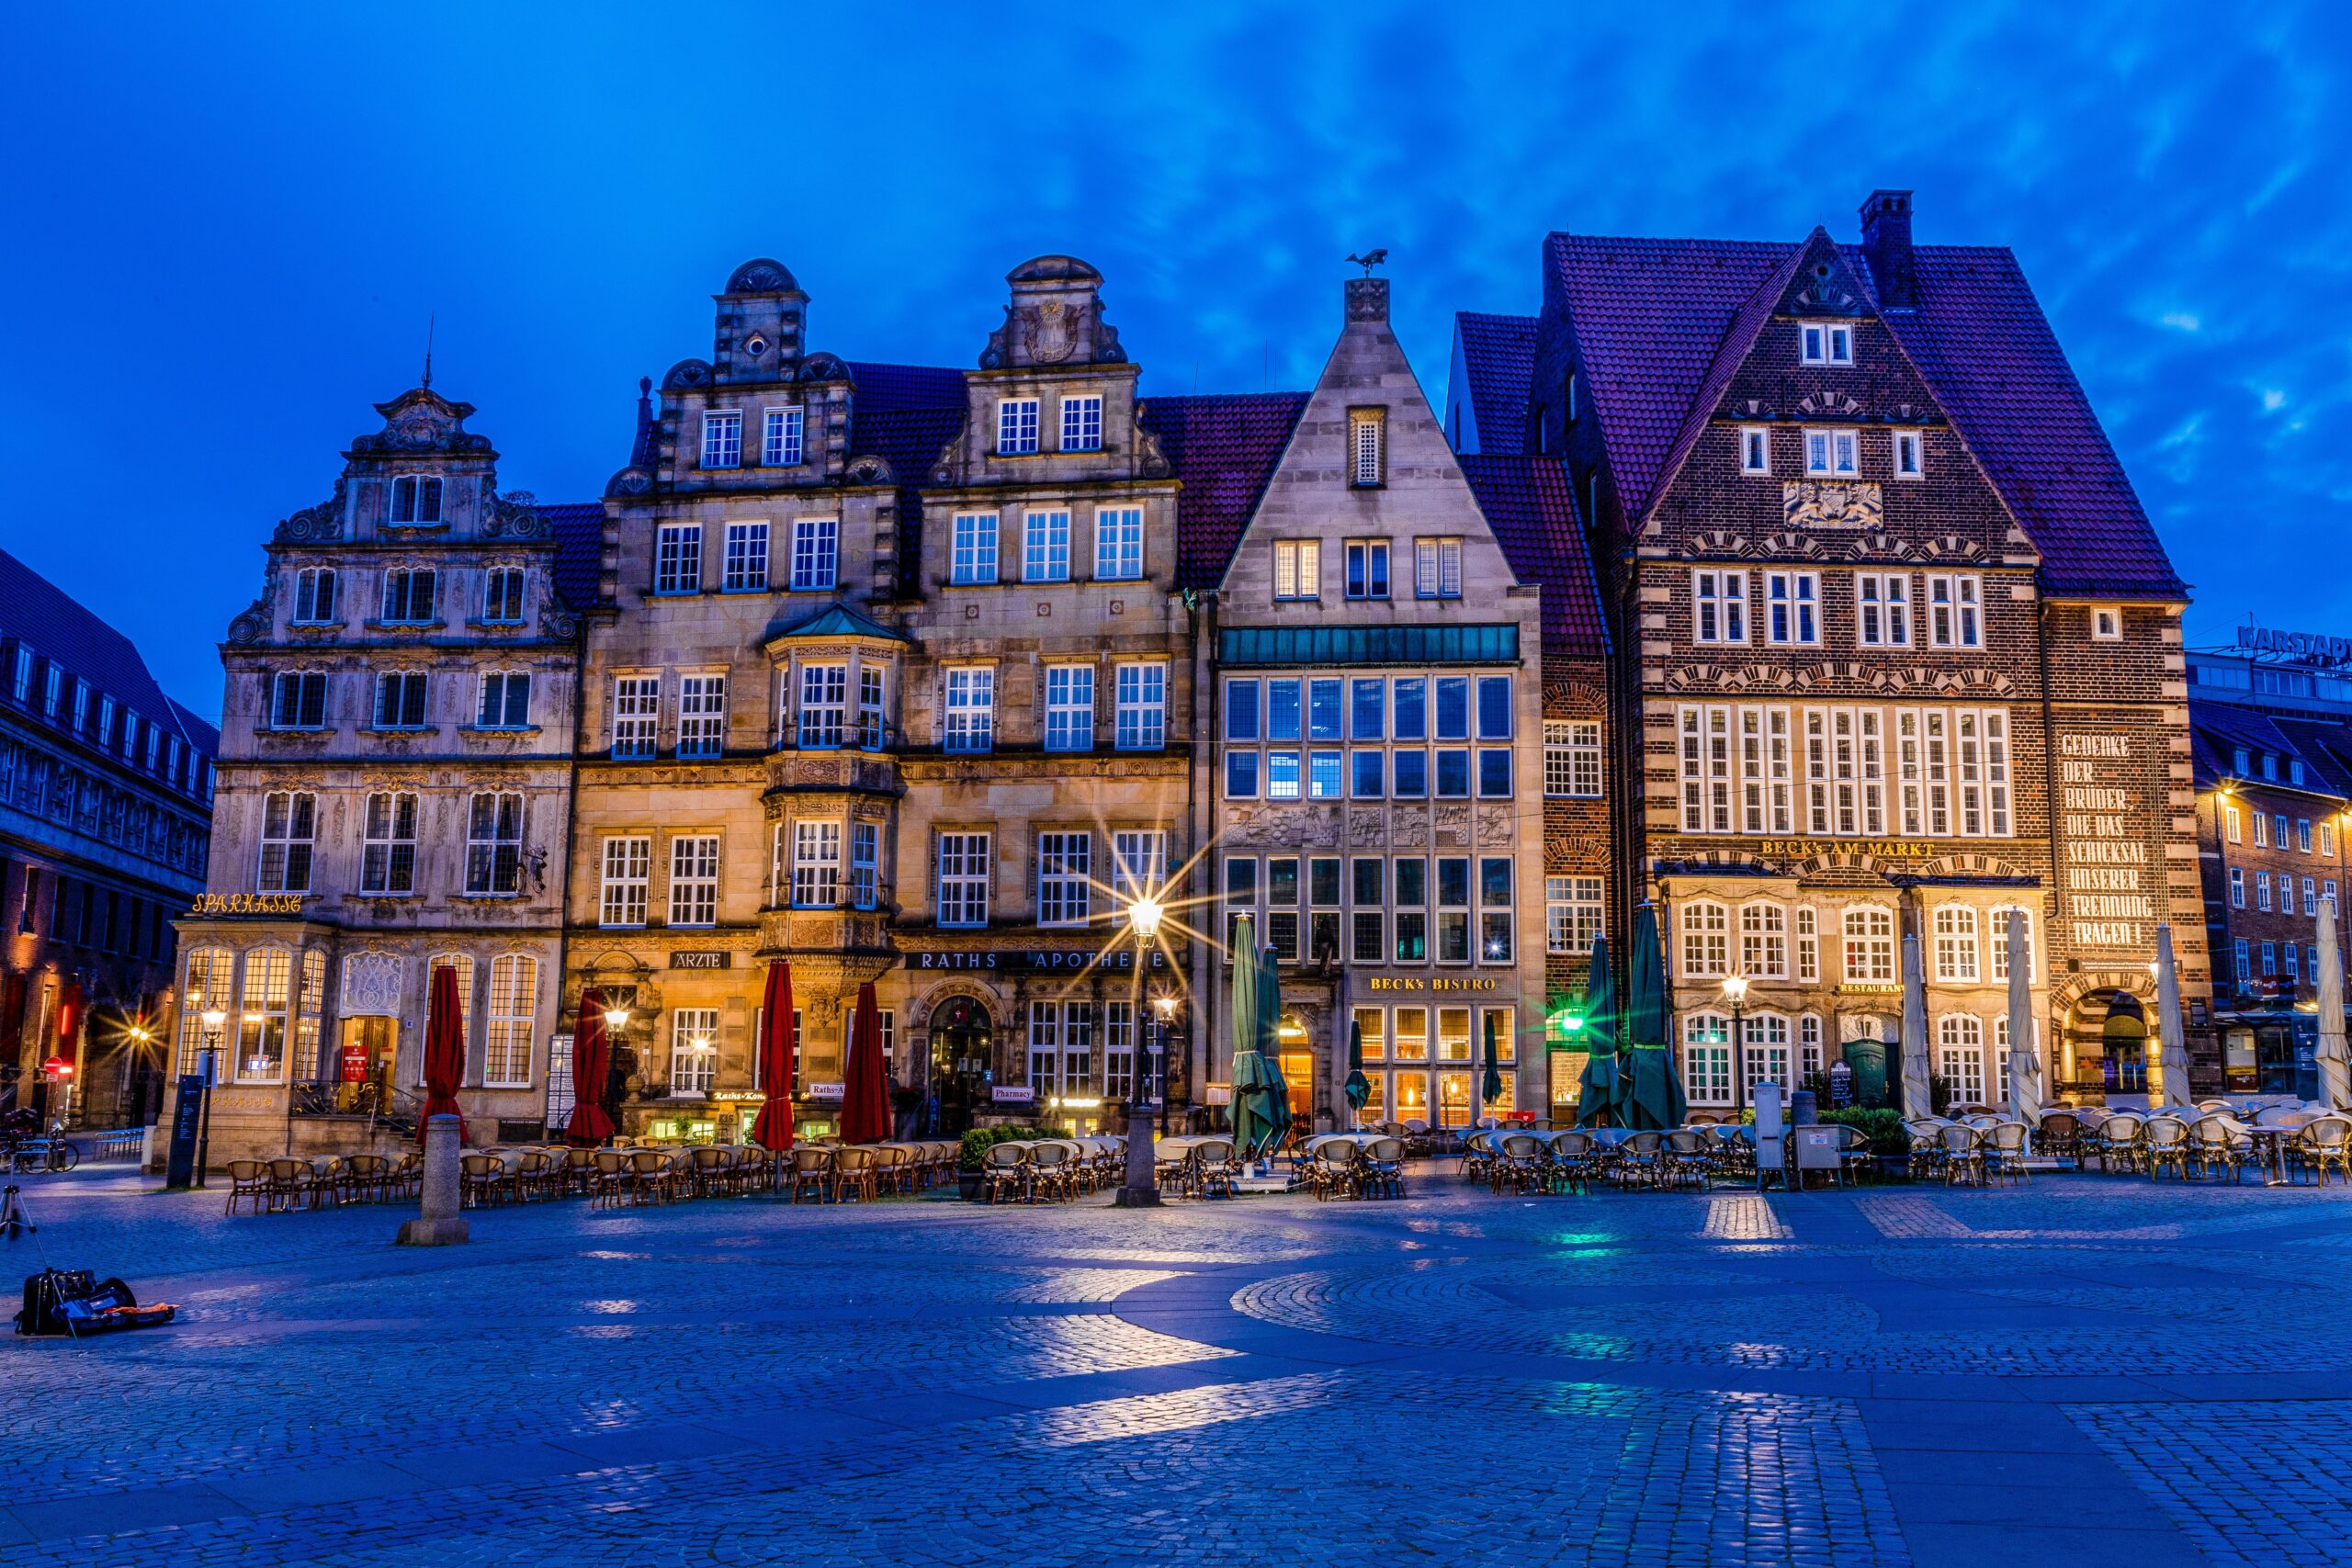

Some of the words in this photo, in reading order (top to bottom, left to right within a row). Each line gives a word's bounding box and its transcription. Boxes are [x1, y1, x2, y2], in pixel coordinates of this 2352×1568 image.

[2062, 734, 2130, 757] GEDENKE
[2064, 761, 2093, 782] DER
[2064, 784, 2133, 811] BRÜDER,
[2066, 815, 2091, 835] DIE
[2095, 815, 2124, 836] DAS
[1761, 841, 1823, 854] BECK's
[1831, 842, 1860, 855] AM
[1868, 843, 1935, 856] MARKT
[2068, 840, 2148, 863] SCHICKSAL
[2070, 867, 2140, 889] UNSERER
[192, 893, 302, 912] SPARKASSE
[2071, 895, 2153, 917] TRENNUNG
[675, 953, 720, 967] ÄRZTE
[922, 953, 996, 968] RATHS
[1035, 952, 1163, 968] APOTHEE
[1370, 977, 1424, 990] BECK's
[1432, 977, 1497, 990] BISTRO
[813, 1085, 844, 1094] Raths-A
[996, 1089, 1031, 1099] Pharmacy
